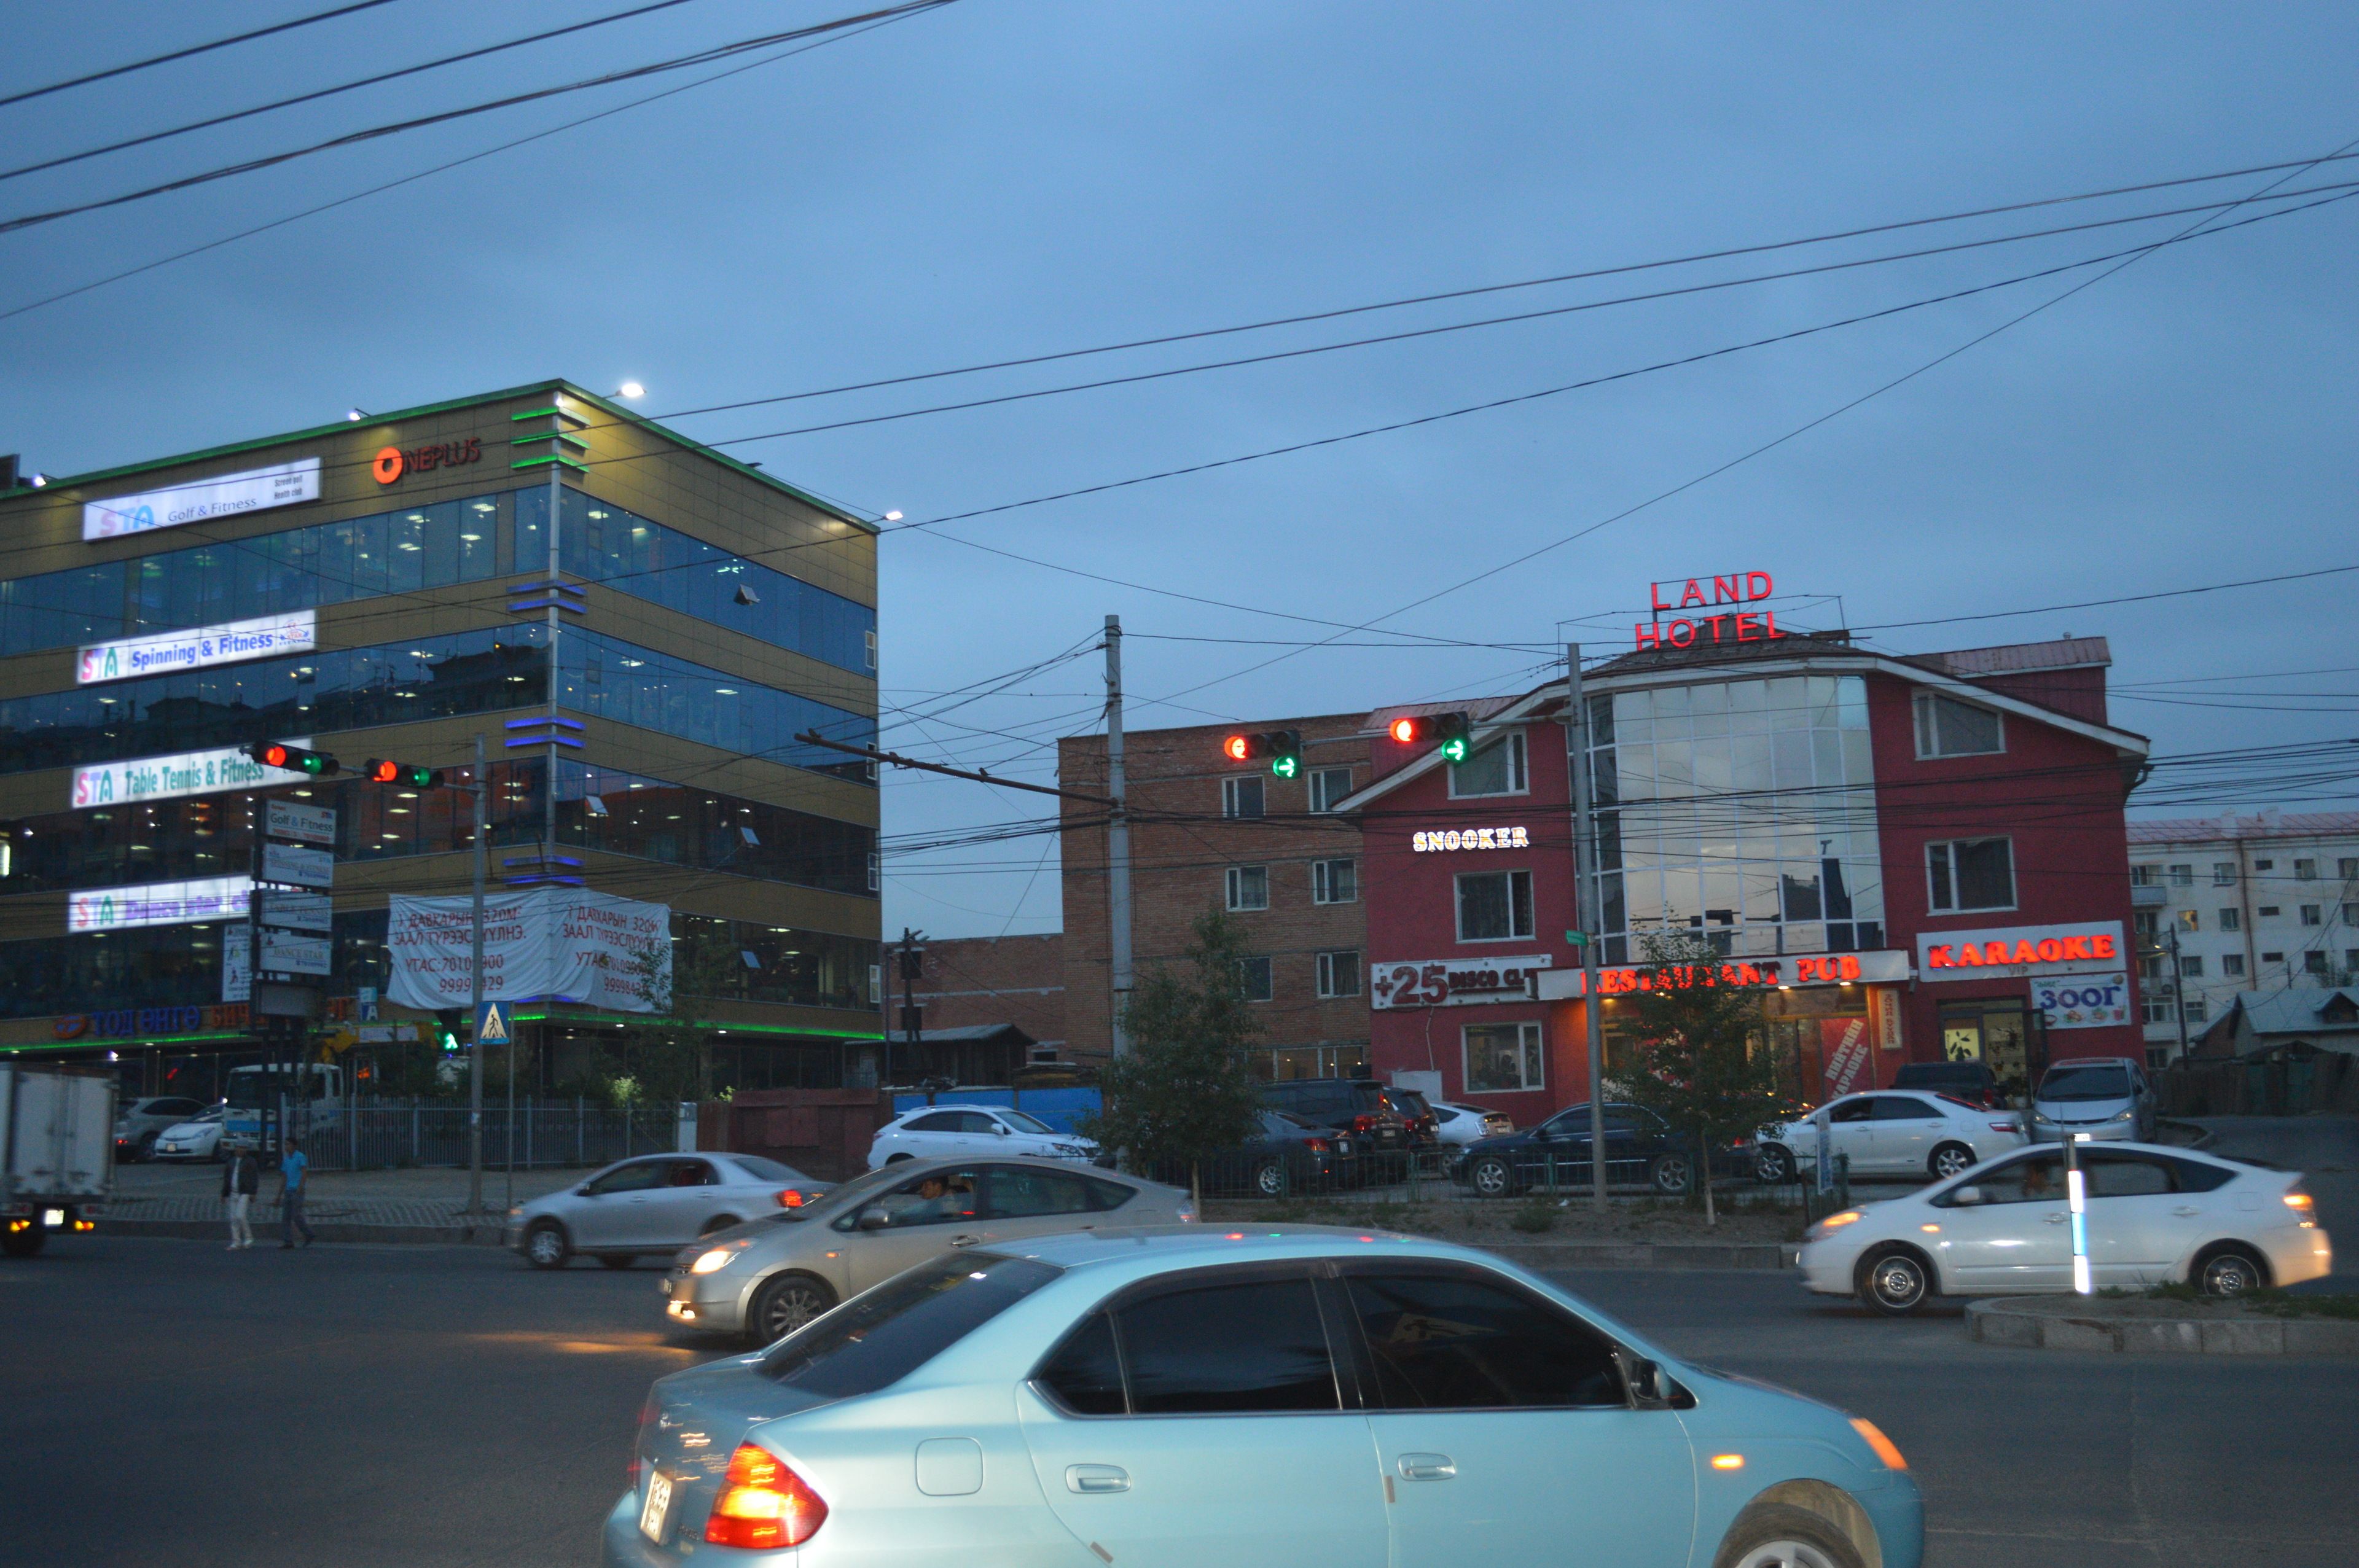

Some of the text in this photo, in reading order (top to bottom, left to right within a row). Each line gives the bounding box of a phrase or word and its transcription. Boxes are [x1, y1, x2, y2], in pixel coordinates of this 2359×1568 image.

[373, 437, 481, 485] ONEPLUS
[100, 504, 154, 536] STA
[168, 497, 257, 522] Golf & Fitness
[1651, 571, 1773, 610] LAND
[1635, 610, 1788, 652] HOTEL
[82, 647, 118, 680] STA
[131, 633, 273, 671] Spinning & Fitness
[76, 770, 113, 805] STA
[125, 756, 265, 795] Table Tennis & Fitness
[271, 813, 290, 825] Golf
[291, 816, 298, 827] &
[1412, 826, 1530, 852] SNOOKER
[77, 894, 114, 927] STA
[563, 923, 593, 939] ЗААЛ
[1928, 934, 2117, 969] KARAOKE
[439, 976, 504, 993] 9999429
[1449, 969, 1499, 988] DISCO
[1503, 967, 1532, 985] CL
[1796, 955, 1861, 982] PUB
[2040, 986, 2121, 1010] ЗООГ
